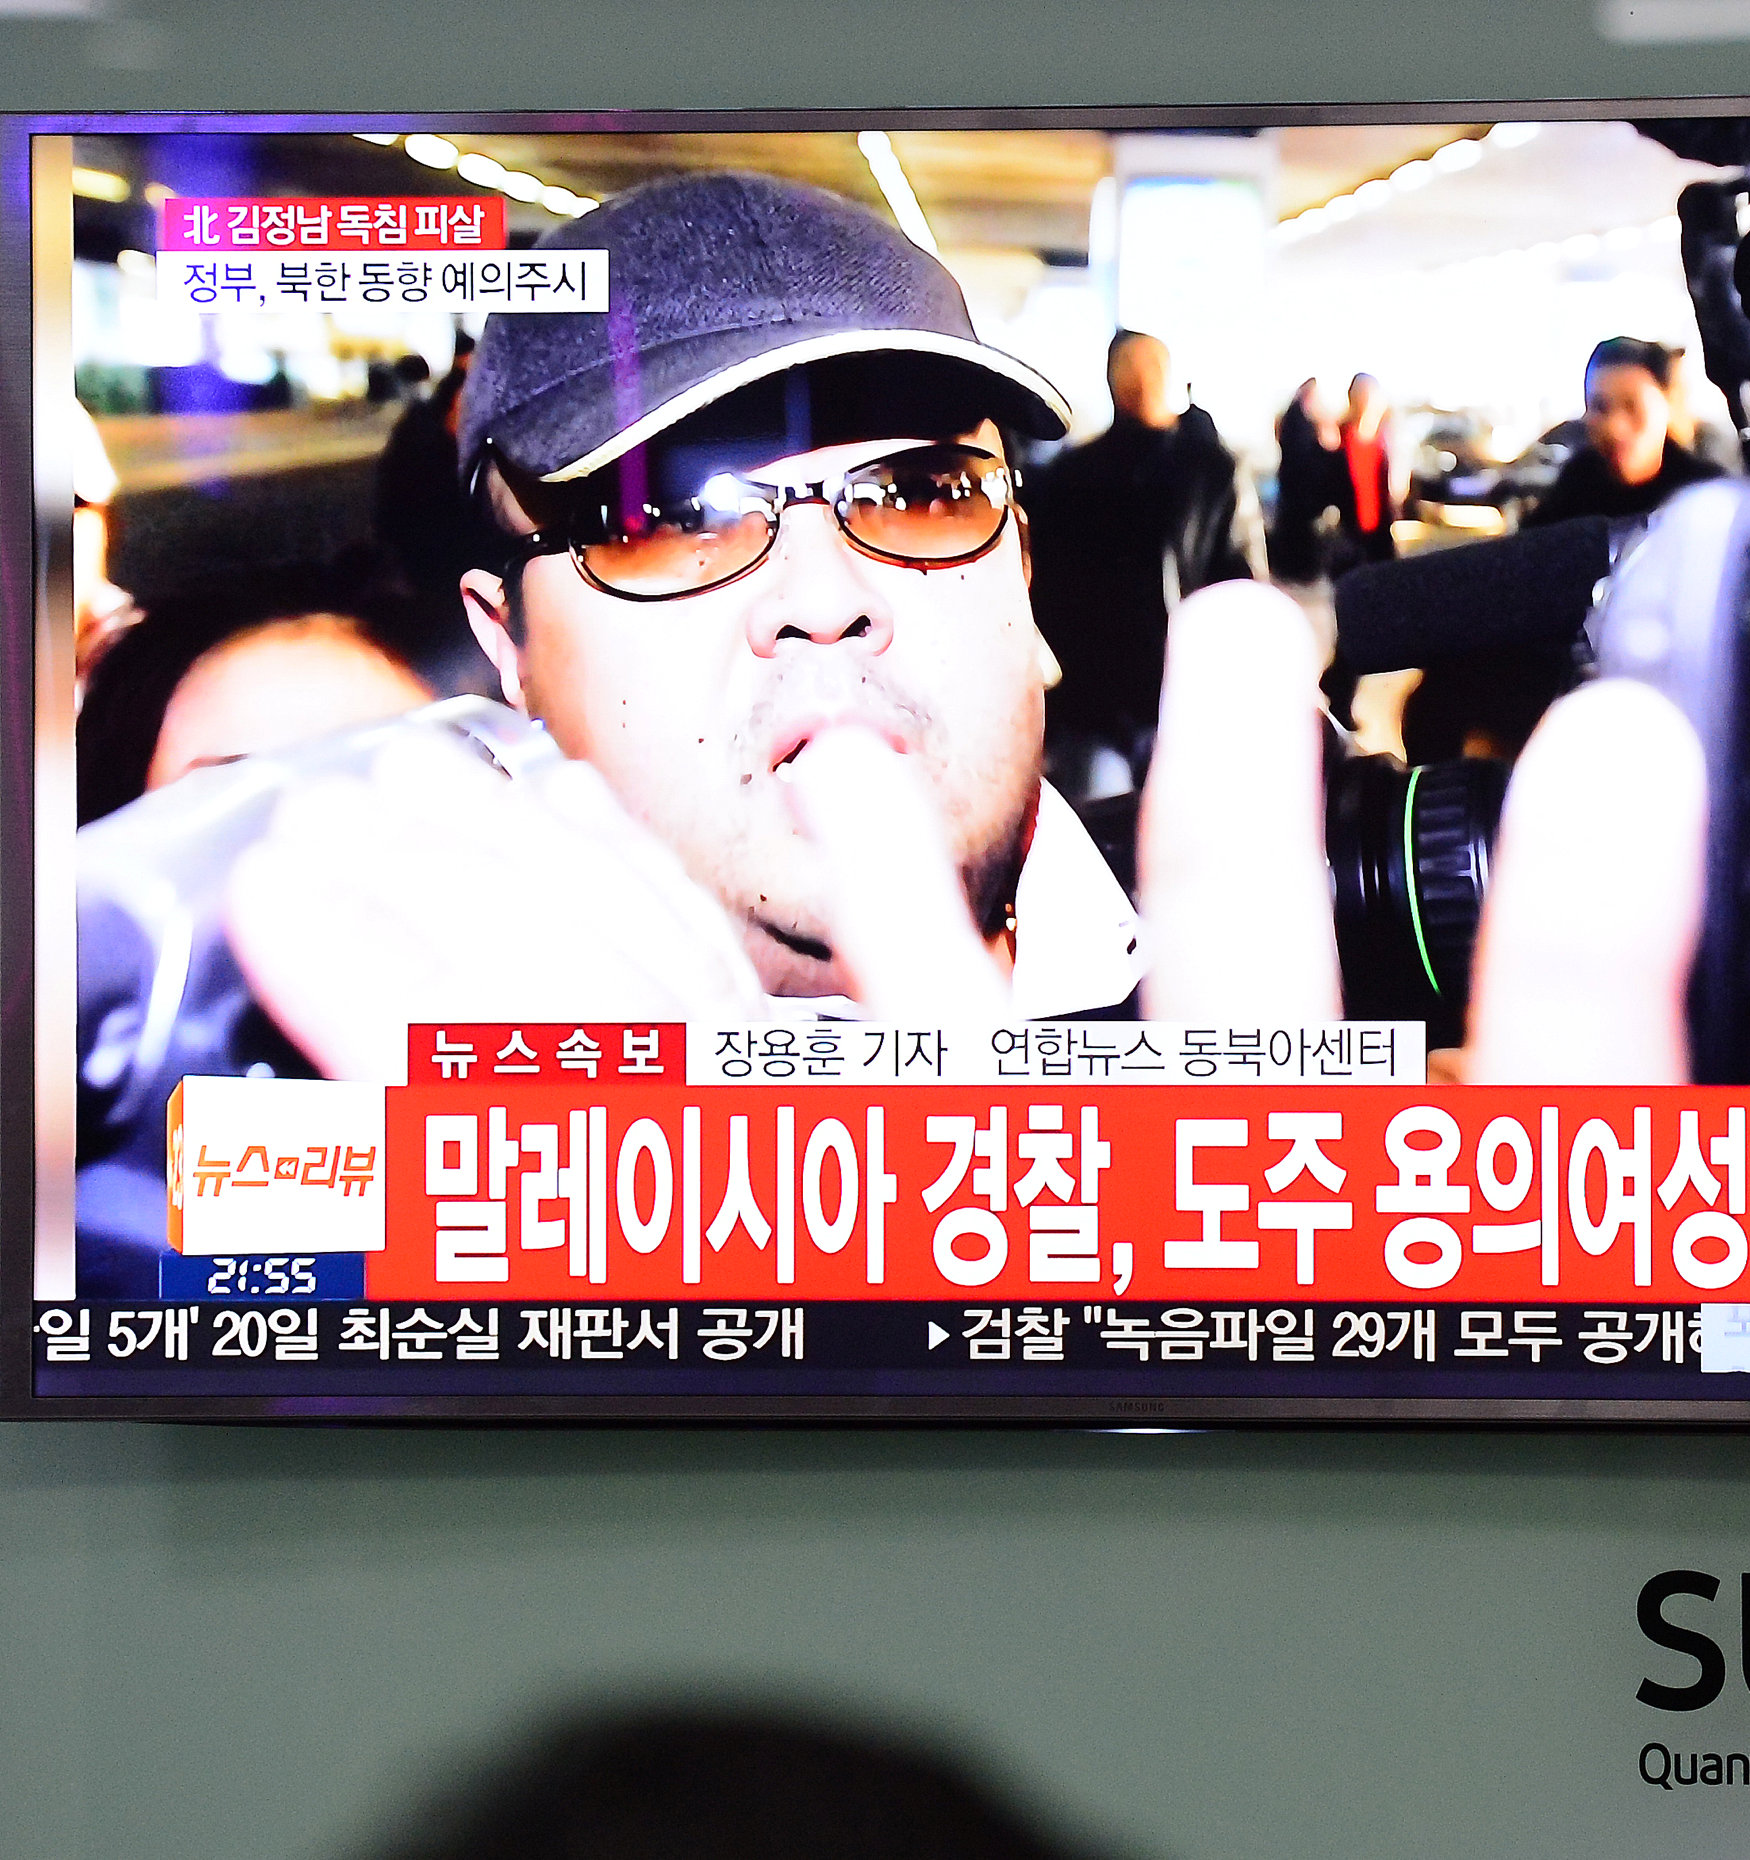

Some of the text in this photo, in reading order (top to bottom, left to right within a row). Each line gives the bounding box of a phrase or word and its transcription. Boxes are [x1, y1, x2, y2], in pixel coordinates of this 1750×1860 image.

[183, 203, 486, 246] 北 김정남 독침 피살
[184, 261, 586, 308] 정부, 북한 동향 예의주시
[714, 1027, 1395, 1078] 장용훈 기자 연합뉴스 동북아센터
[425, 1106, 897, 1284] 말레이시아
[921, 1104, 1134, 1296] 경찰,
[1164, 1112, 1353, 1285] 도주
[1375, 1105, 1748, 1290] 용의여성
[207, 1257, 317, 1295] 21:55
[33, 1308, 91, 1362] 일
[211, 1307, 319, 1361] 20일
[338, 1307, 500, 1360] 최순실
[517, 1307, 679, 1360] 재판서
[697, 1307, 804, 1361] 공개
[961, 1306, 1071, 1361] 검찰
[1083, 1305, 1315, 1362] "녹음파일
[1331, 1309, 1436, 1362] 29개
[1453, 1310, 1563, 1363] 모두
